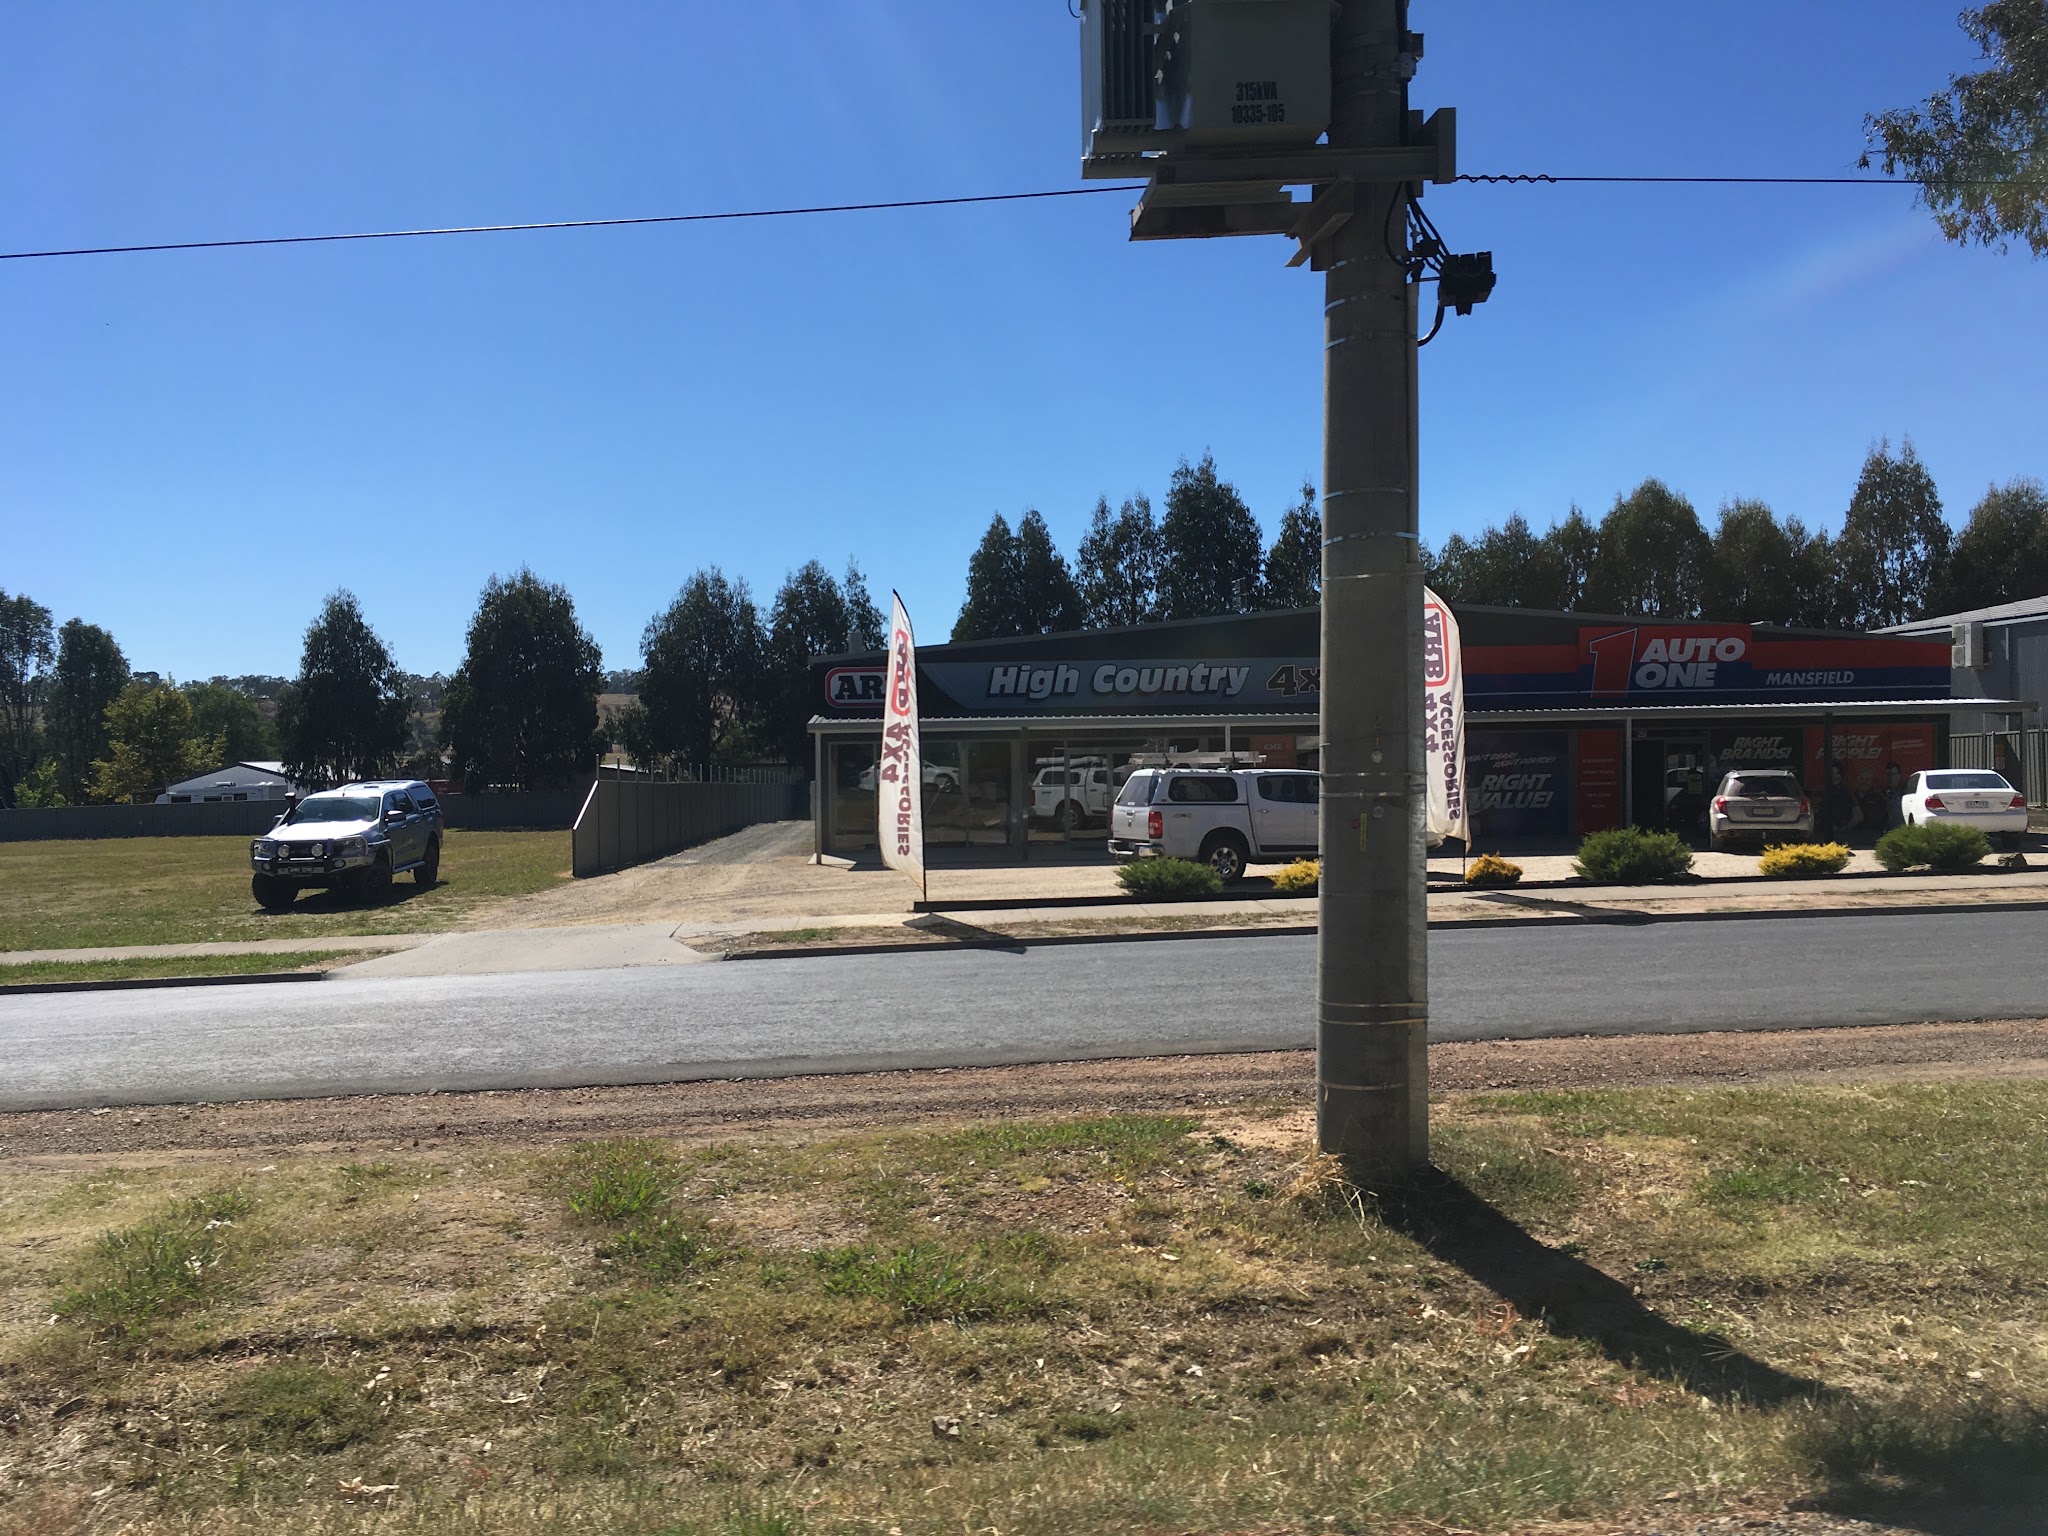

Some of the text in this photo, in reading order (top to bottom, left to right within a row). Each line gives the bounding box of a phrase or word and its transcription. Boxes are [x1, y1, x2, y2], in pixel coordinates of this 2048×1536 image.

[1236, 81, 1278, 101] 315kVA
[1639, 637, 1746, 662] AUTO
[989, 662, 1321, 699] High Country 4x
[1635, 662, 1718, 688] ONE
[1765, 670, 1855, 686] MANSFIELD
[834, 675, 889, 700] AR
[1733, 736, 1784, 749] RIGHT
[1720, 747, 1793, 760] BRANDS!
[1481, 773, 1552, 791] RIGHT
[1470, 791, 1554, 809] VALUE!
